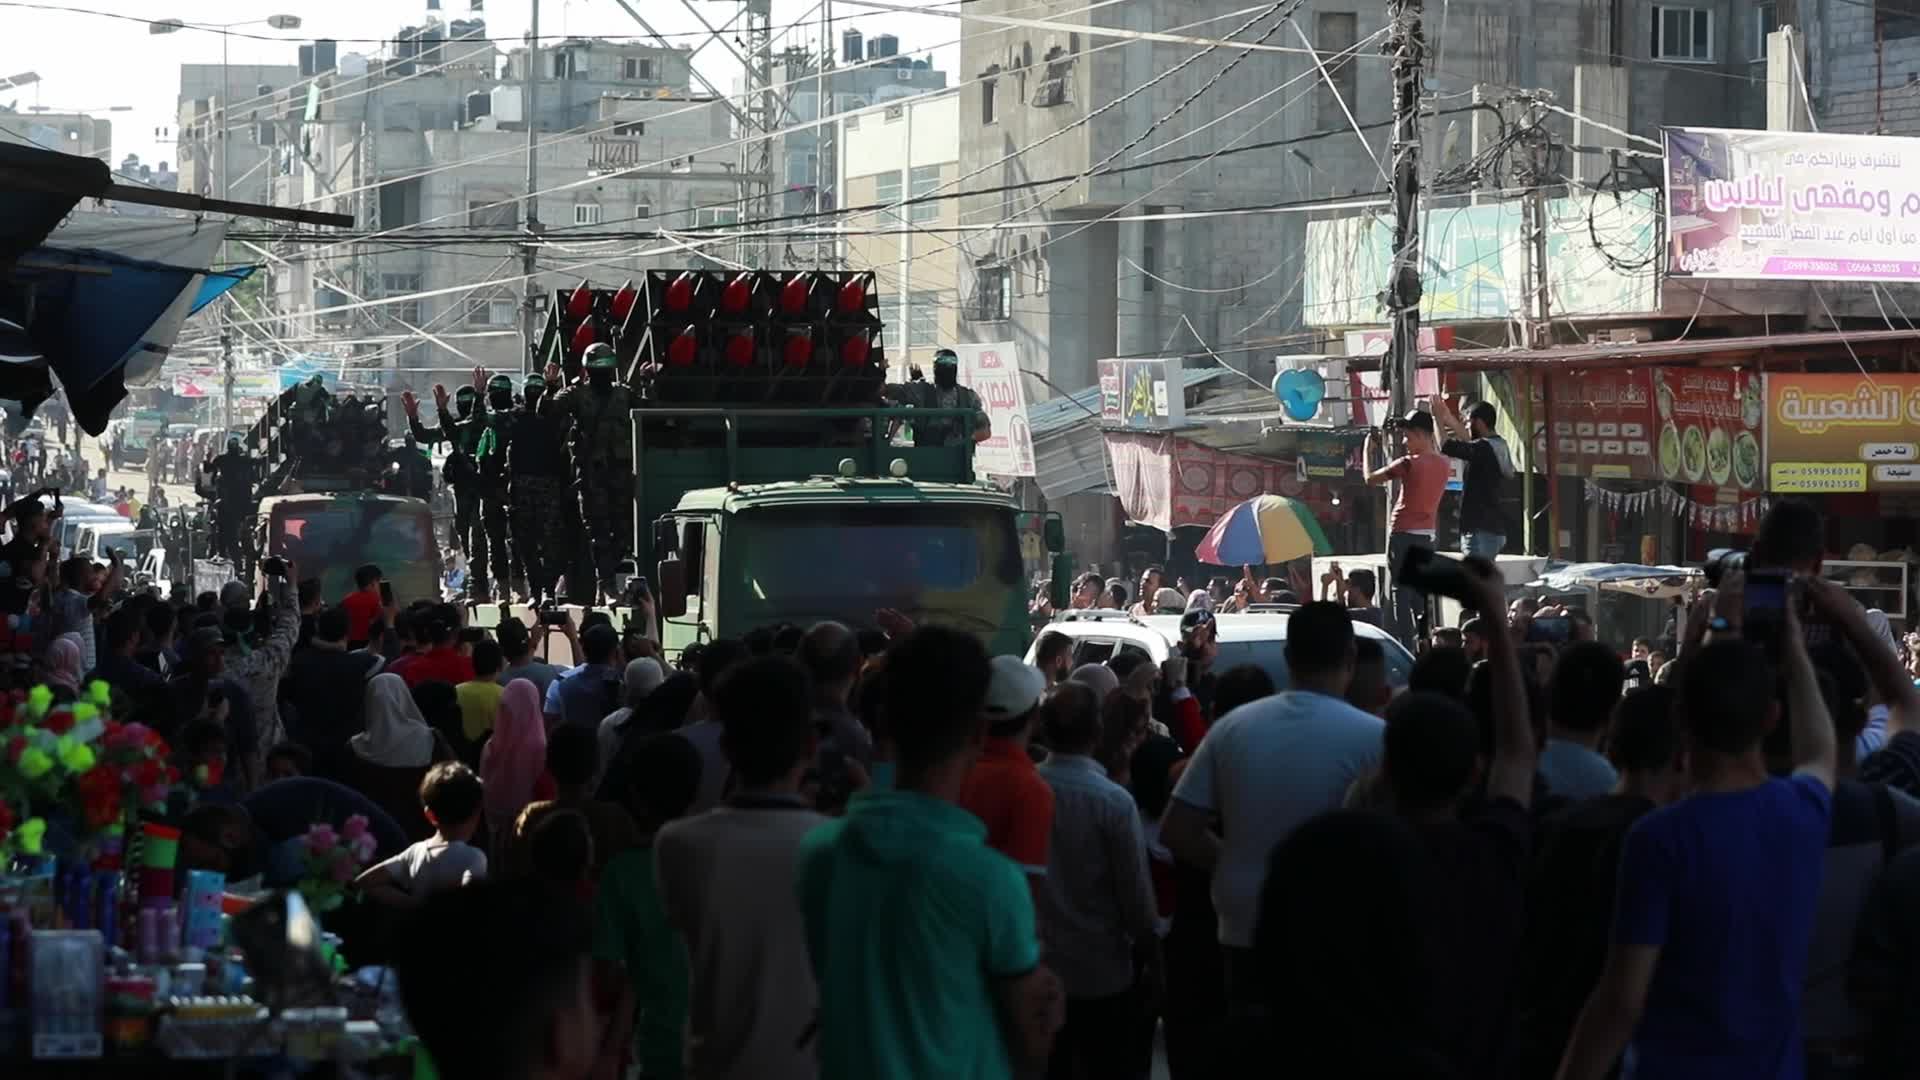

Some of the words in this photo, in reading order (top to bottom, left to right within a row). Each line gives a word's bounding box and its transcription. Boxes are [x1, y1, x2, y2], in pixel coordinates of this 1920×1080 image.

[1705, 173, 1784, 215] ليلاس
[1793, 180, 1890, 215] ومقهى
[1782, 386, 1900, 429] الشعبية
